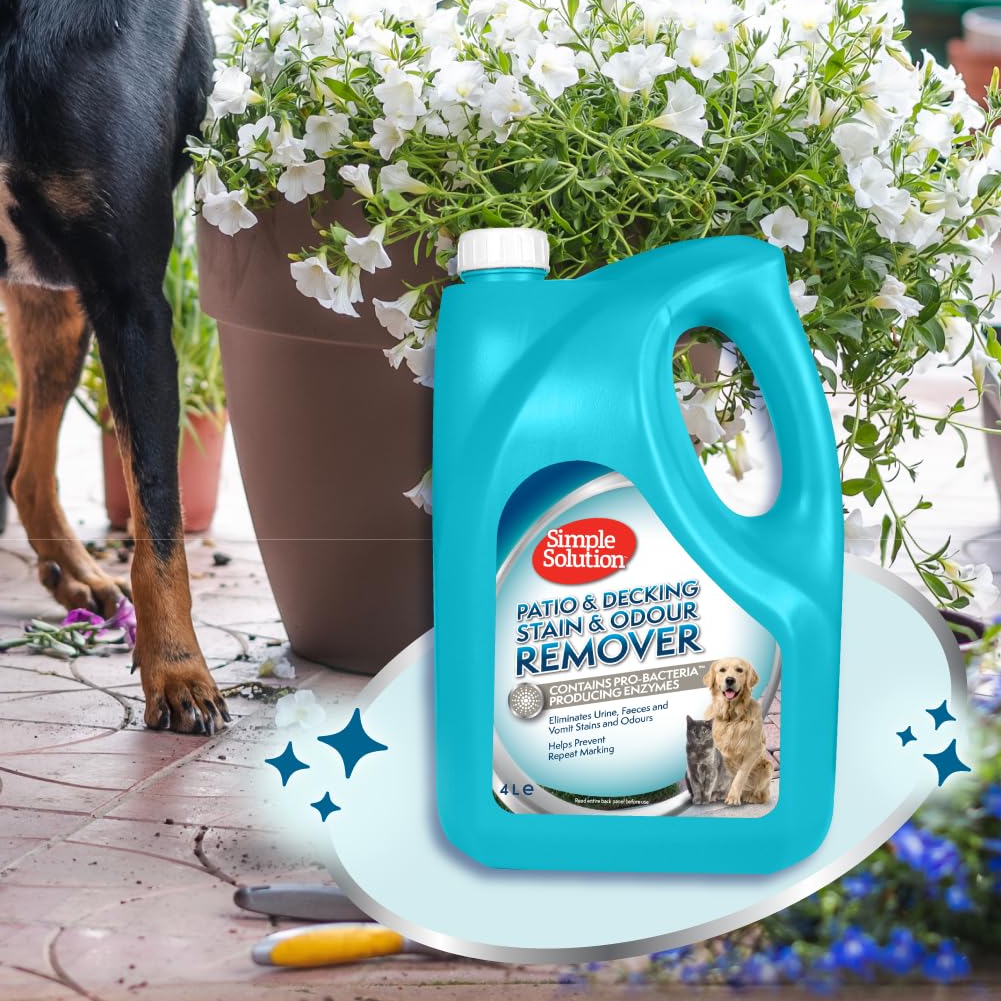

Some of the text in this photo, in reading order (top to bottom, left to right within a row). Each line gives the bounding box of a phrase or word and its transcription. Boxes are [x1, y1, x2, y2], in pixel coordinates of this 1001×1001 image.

[547, 529, 616, 550] Simple
[543, 549, 626, 569] Solution
[517, 580, 699, 620] PATIO & DECKING
[516, 602, 700, 642] STAIN & ODOUR
[516, 624, 703, 676] REMOVER
[549, 678, 611, 695] CONTAINS
[549, 680, 680, 706] PRODUCING ENZYMES
[549, 700, 669, 725] Eliminates Urine, Faeces and
[548, 715, 654, 735] Vomit Stains and Odours
[548, 736, 606, 751] Helps Prevent
[548, 746, 615, 761] Repeat Marking
